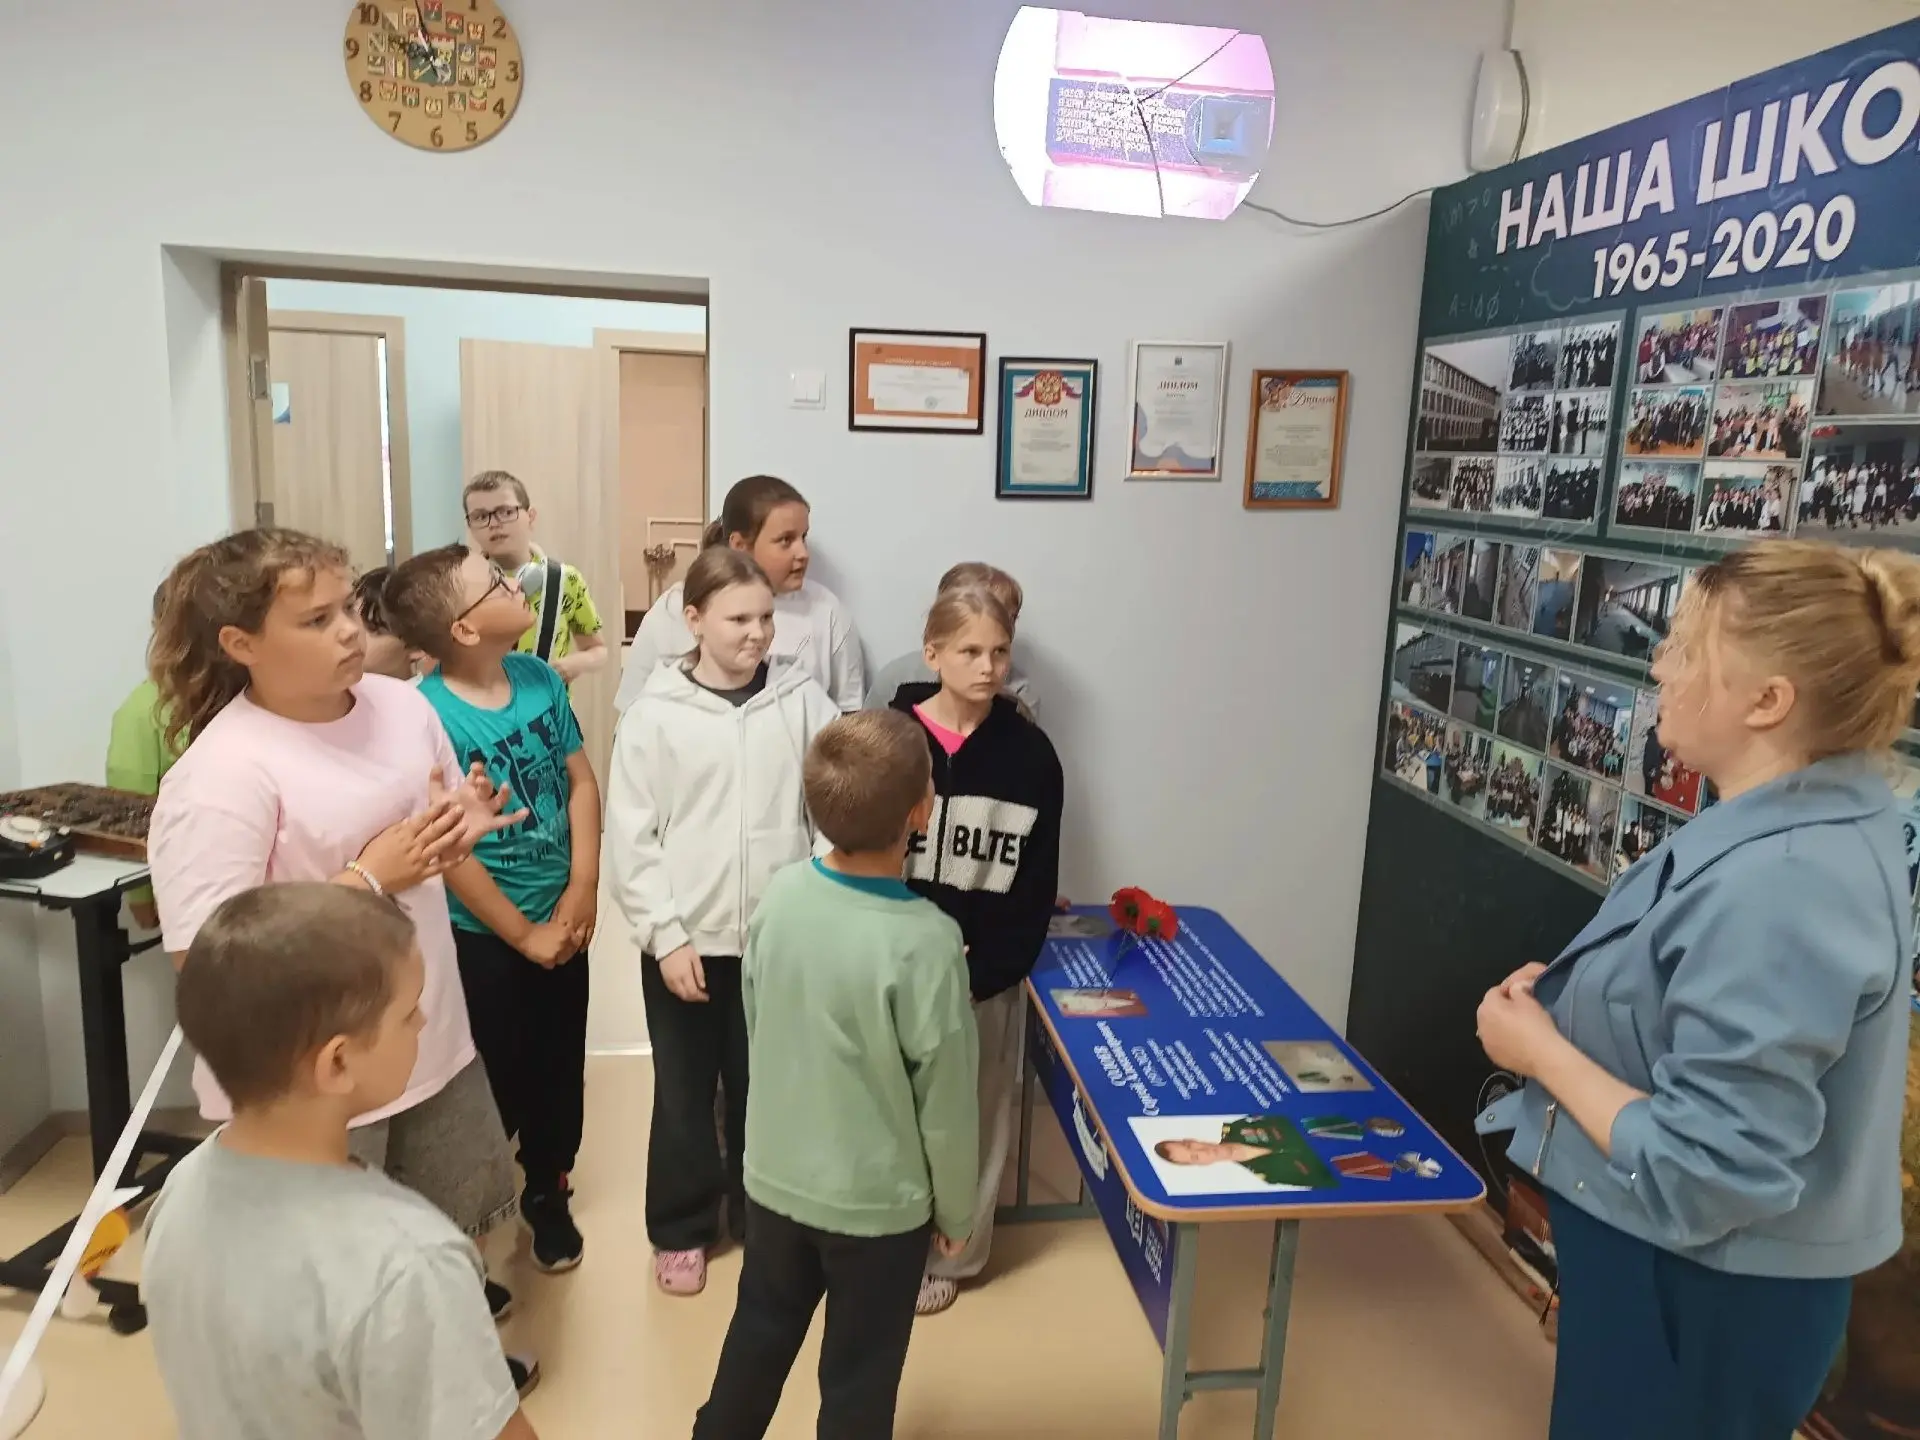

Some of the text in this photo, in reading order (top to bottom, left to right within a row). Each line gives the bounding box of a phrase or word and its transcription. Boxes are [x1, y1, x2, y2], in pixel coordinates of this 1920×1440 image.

[357, 2, 380, 26] 10
[492, 16, 508, 39] 2
[345, 37, 360, 59] 9
[505, 60, 520, 82] 3
[359, 80, 373, 103] 8
[492, 97, 506, 120] 4
[388, 110, 401, 133] 7
[465, 121, 478, 142] 5
[430, 125, 444, 148] 6
[1496, 60, 1920, 255] НАША ШКО
[1593, 194, 1857, 300] 1965-2020
